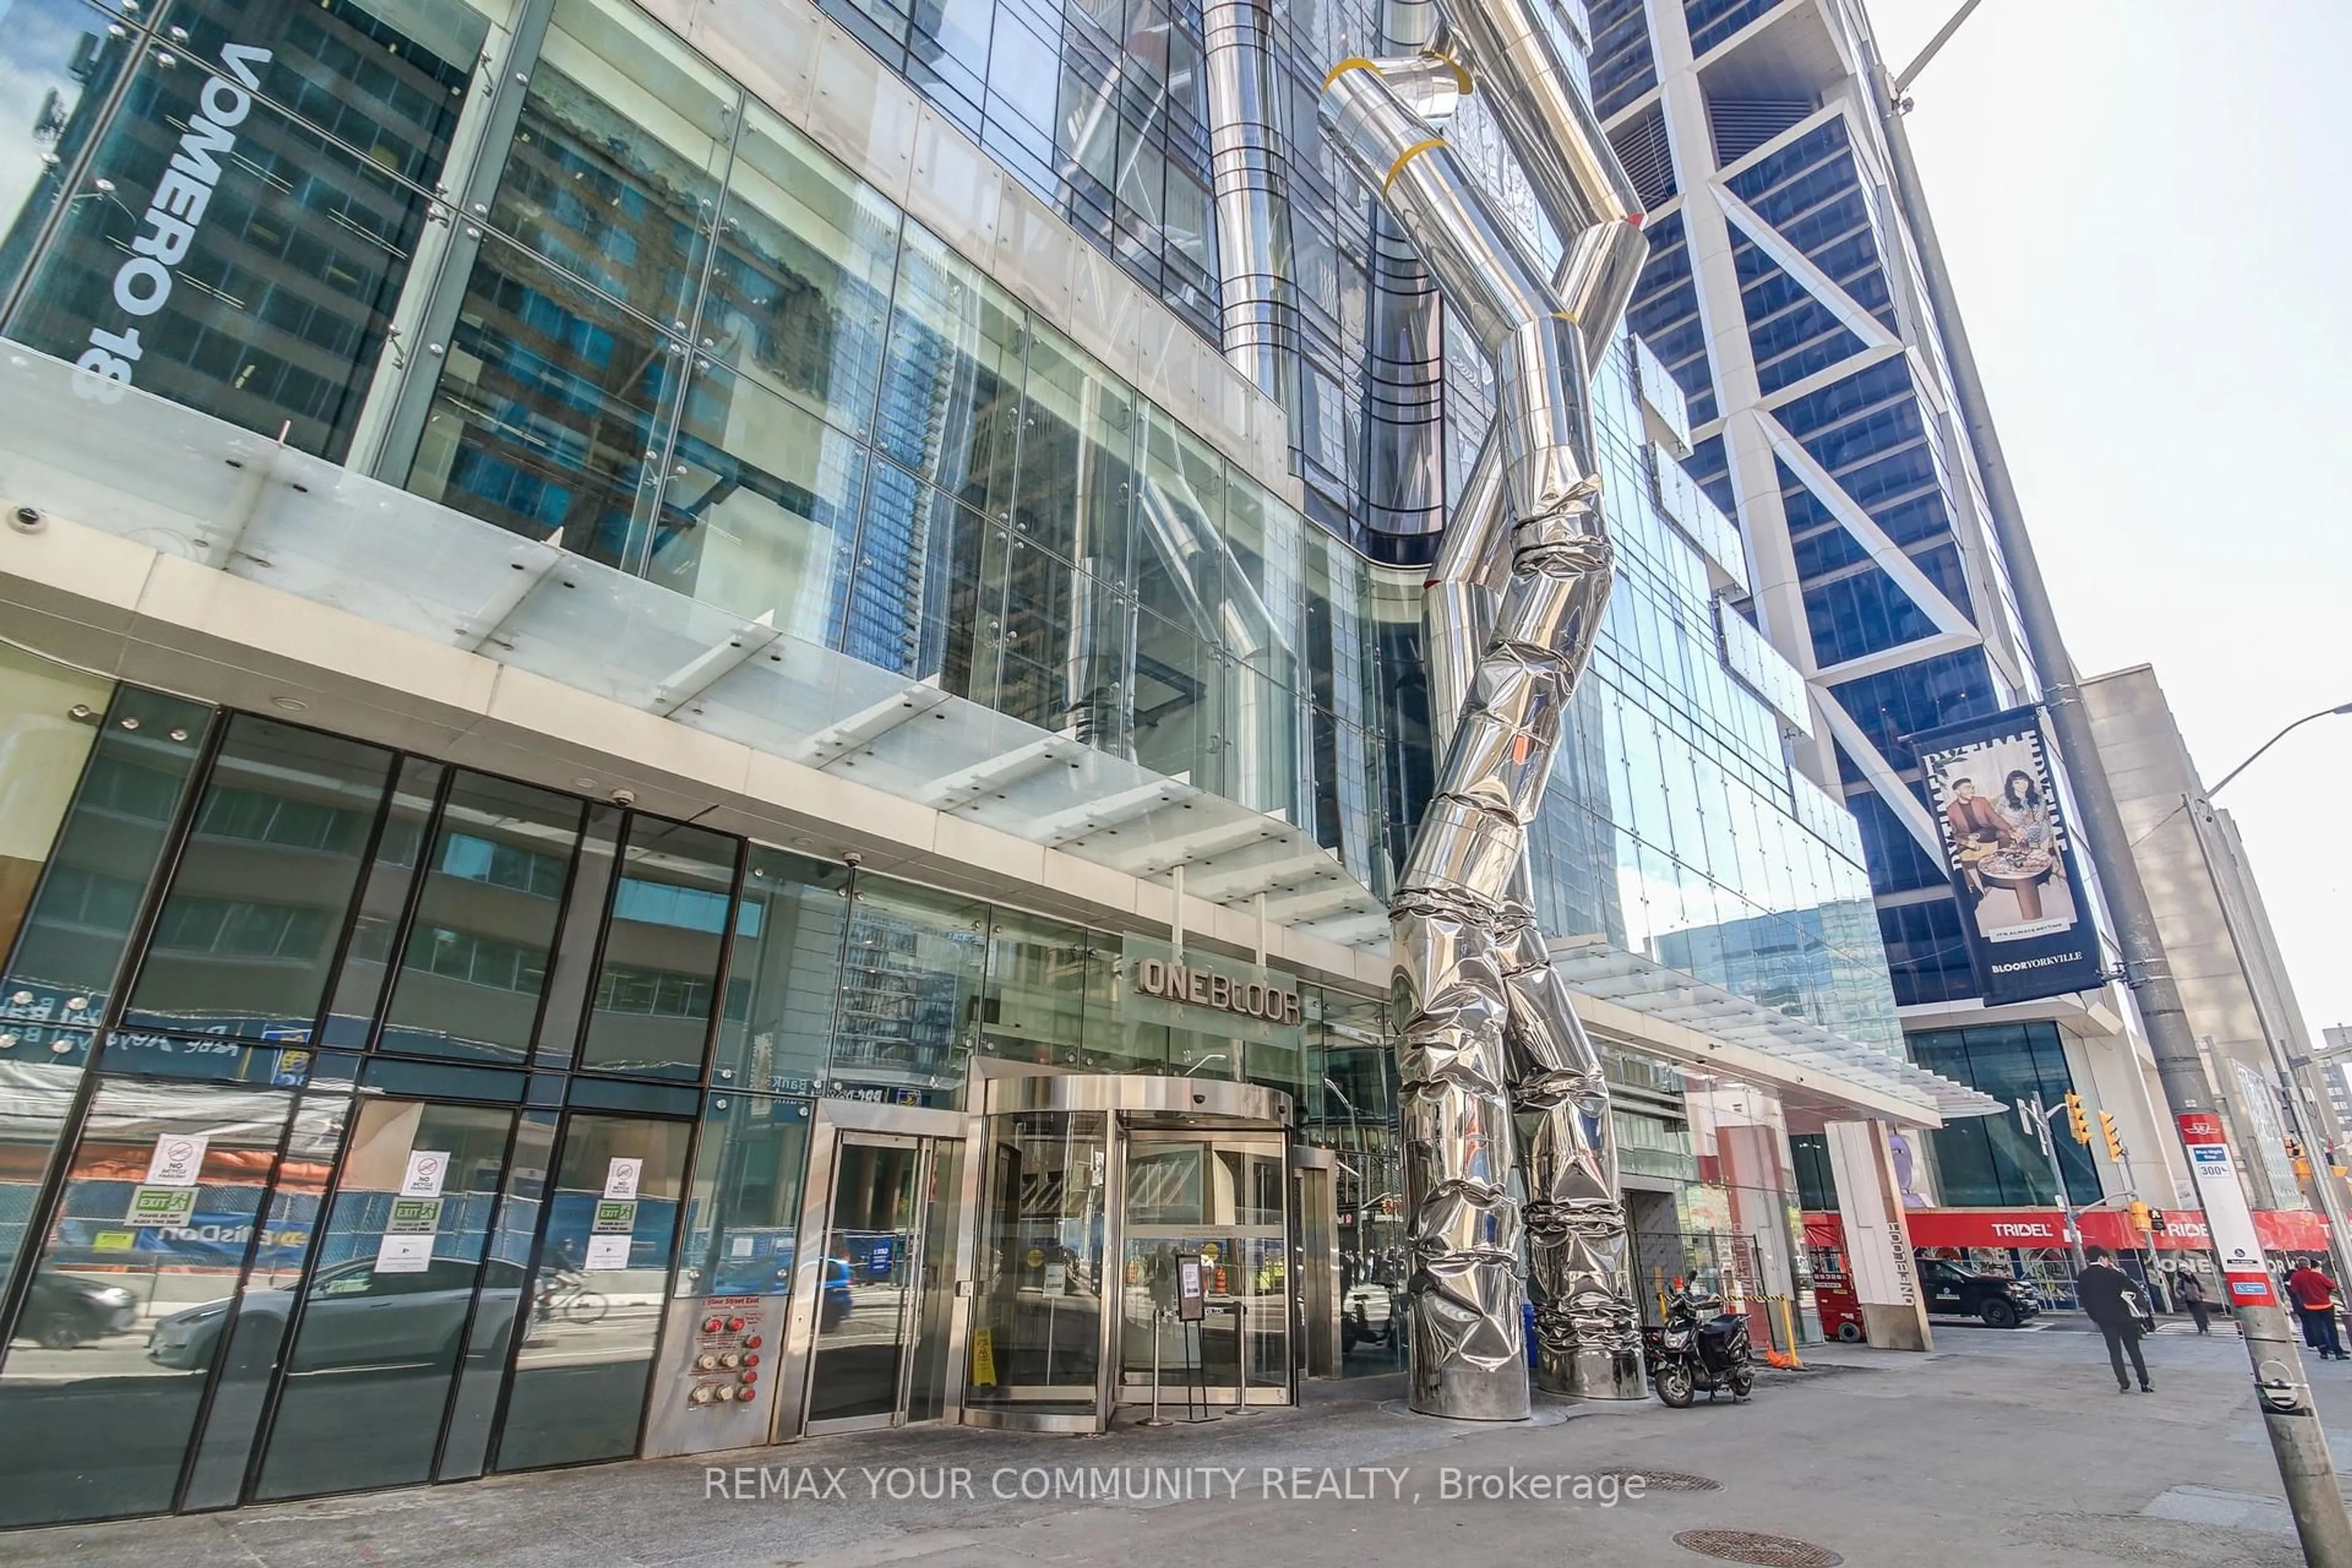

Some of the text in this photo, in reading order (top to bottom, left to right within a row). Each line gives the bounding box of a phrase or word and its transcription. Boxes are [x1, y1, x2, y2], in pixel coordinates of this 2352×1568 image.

[71, 42, 273, 404] VOMERO 18
[1991, 951, 2082, 974] BLOORYORKVILLE
[1137, 957, 1301, 1025] ONEBLOOR
[2200, 1166, 2222, 1175] 300
[139, 1199, 167, 1207] EXIT
[396, 1208, 421, 1216] EXIT
[601, 1209, 619, 1218] EXIT
[1991, 1224, 2053, 1237] TRIDEL
[2160, 1223, 2210, 1237] RIDE
